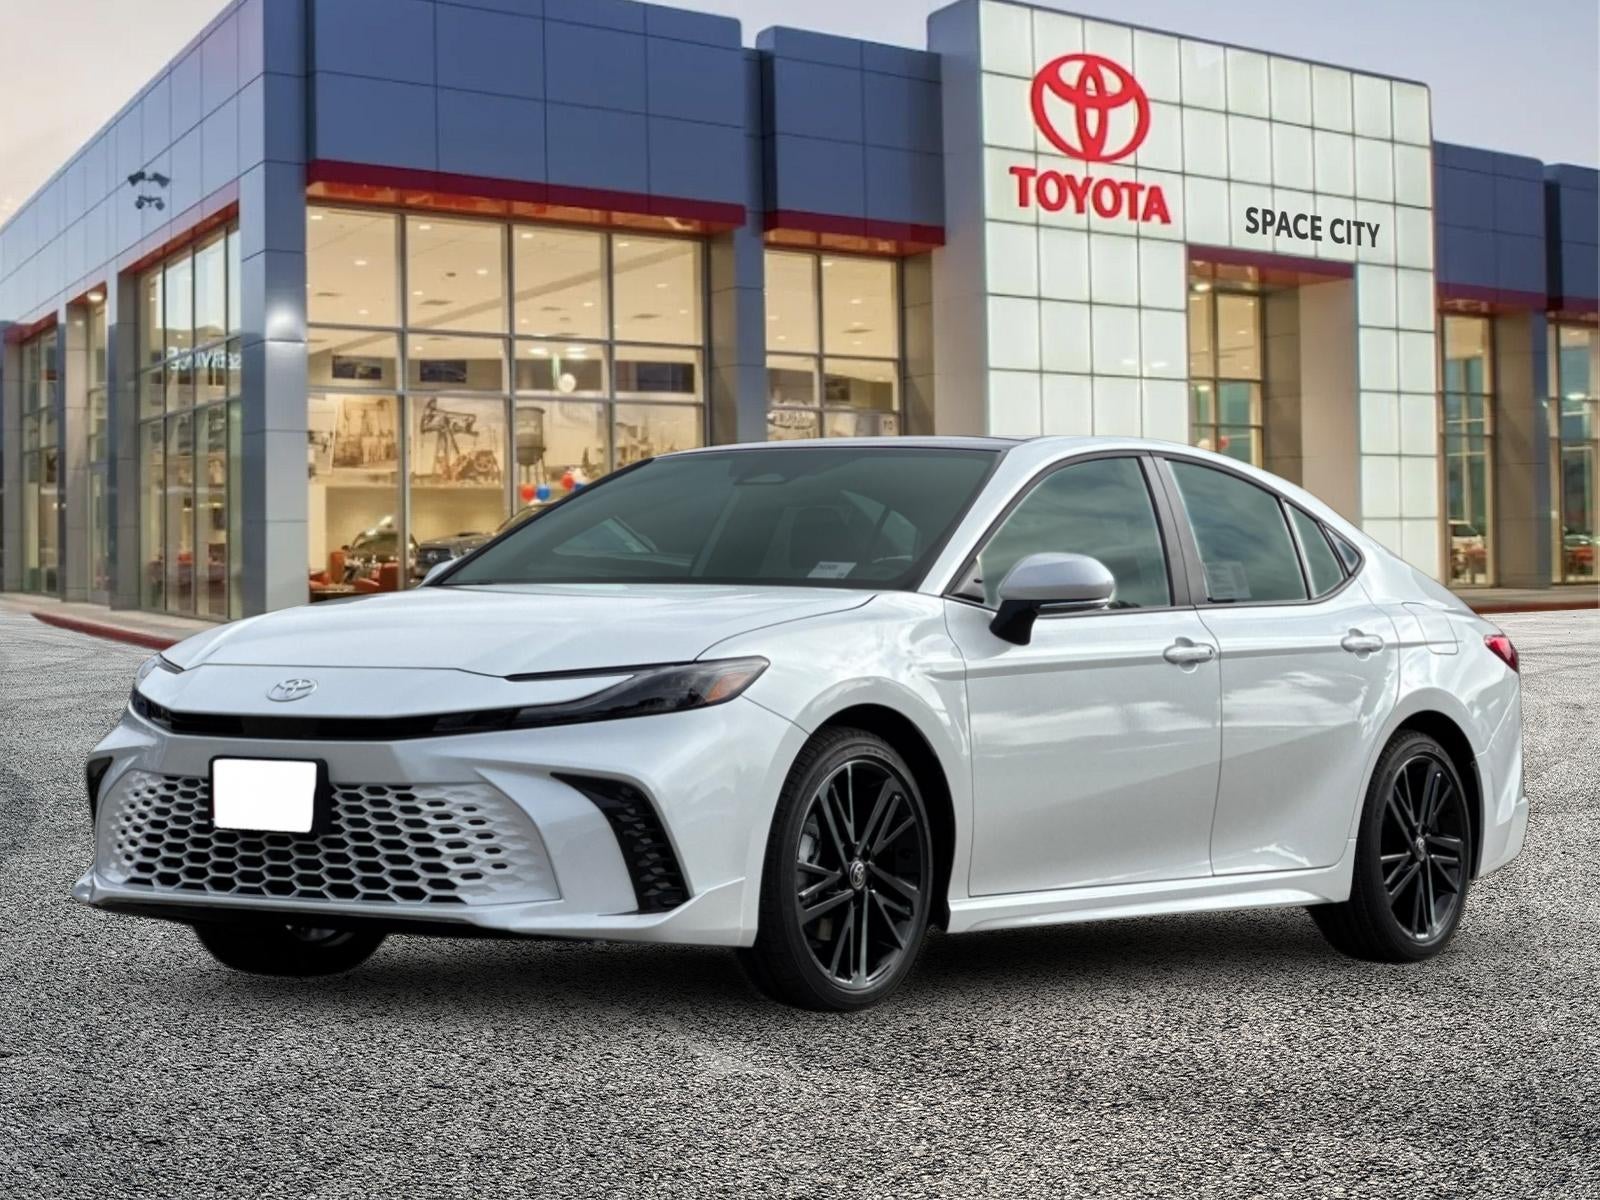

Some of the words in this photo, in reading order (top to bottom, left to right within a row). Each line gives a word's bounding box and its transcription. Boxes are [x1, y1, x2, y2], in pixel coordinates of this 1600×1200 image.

[1010, 166, 1171, 224] TOYOTA
[1245, 206, 1322, 241] SPACE
[1329, 219, 1380, 248] CITY
